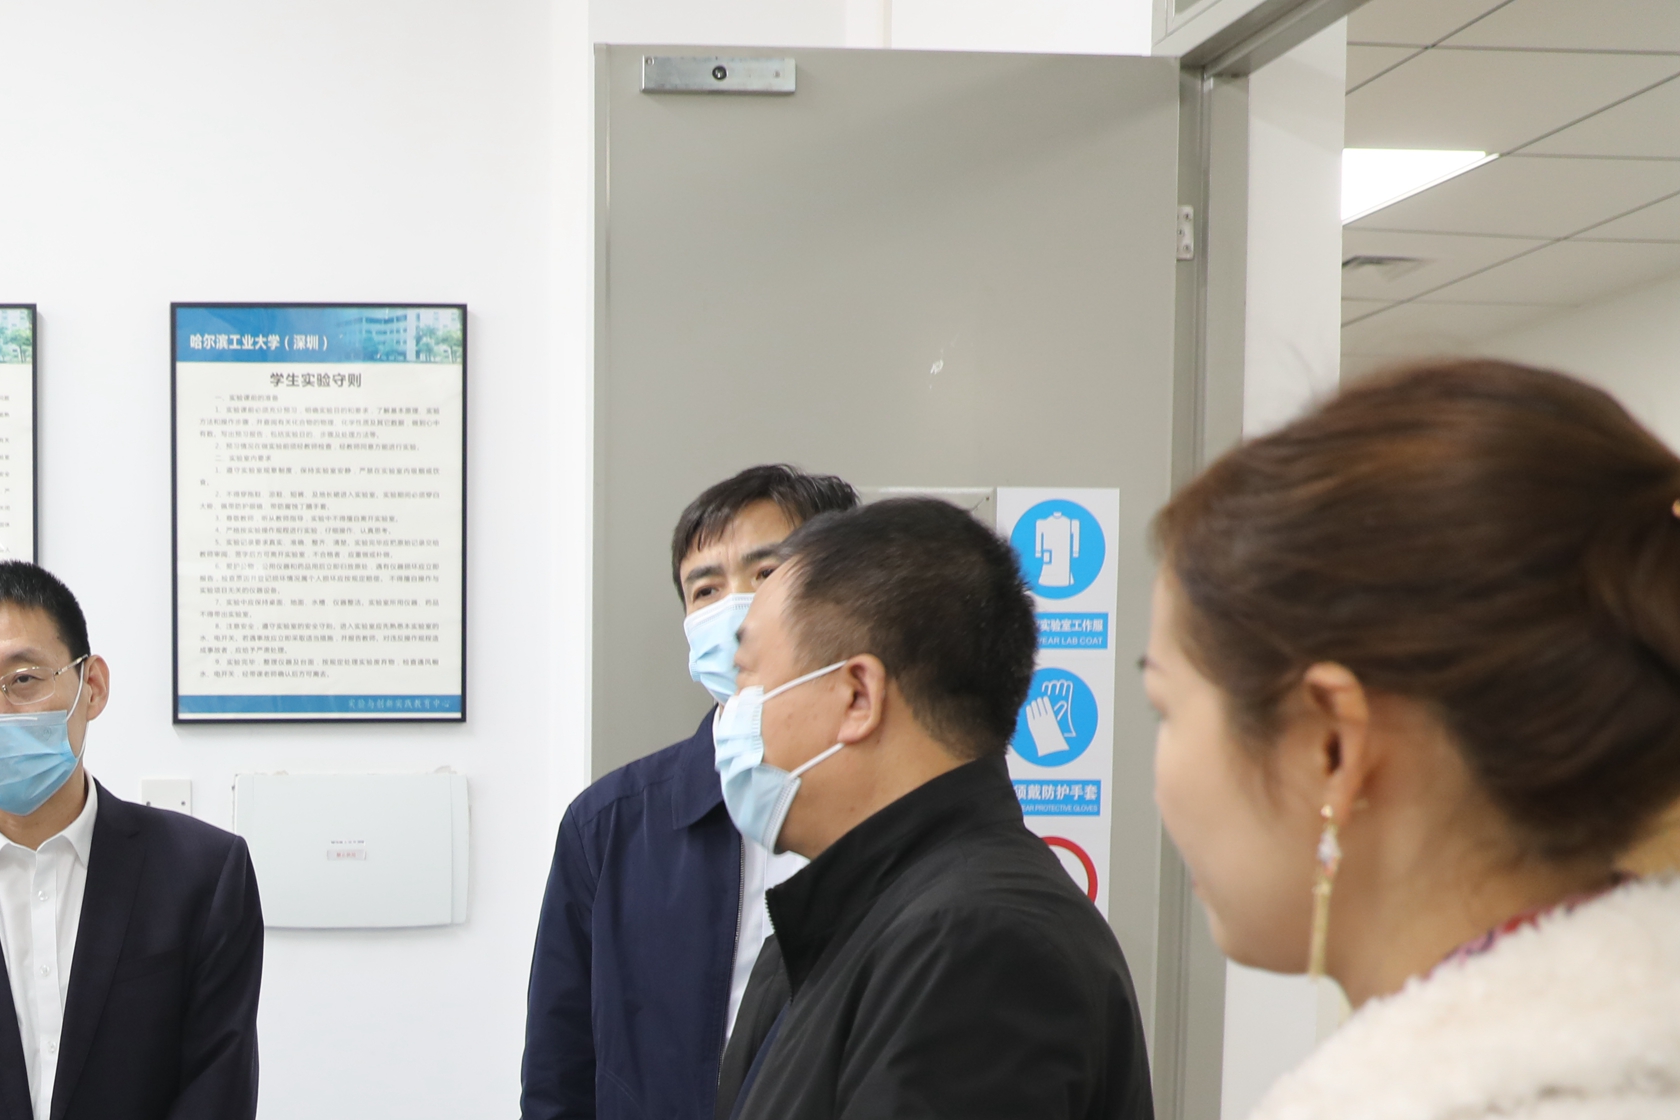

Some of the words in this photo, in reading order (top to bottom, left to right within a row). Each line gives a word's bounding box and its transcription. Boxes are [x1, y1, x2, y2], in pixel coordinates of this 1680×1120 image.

[189, 334, 328, 351] 哈尔滨工业大学（深圳）
[269, 372, 362, 388] 学生实验守则
[1061, 637, 1078, 645] LAB
[1080, 637, 1103, 645] COAT
[1035, 804, 1072, 812] PROTECTIVE
[1074, 804, 1098, 812] GLOVES
